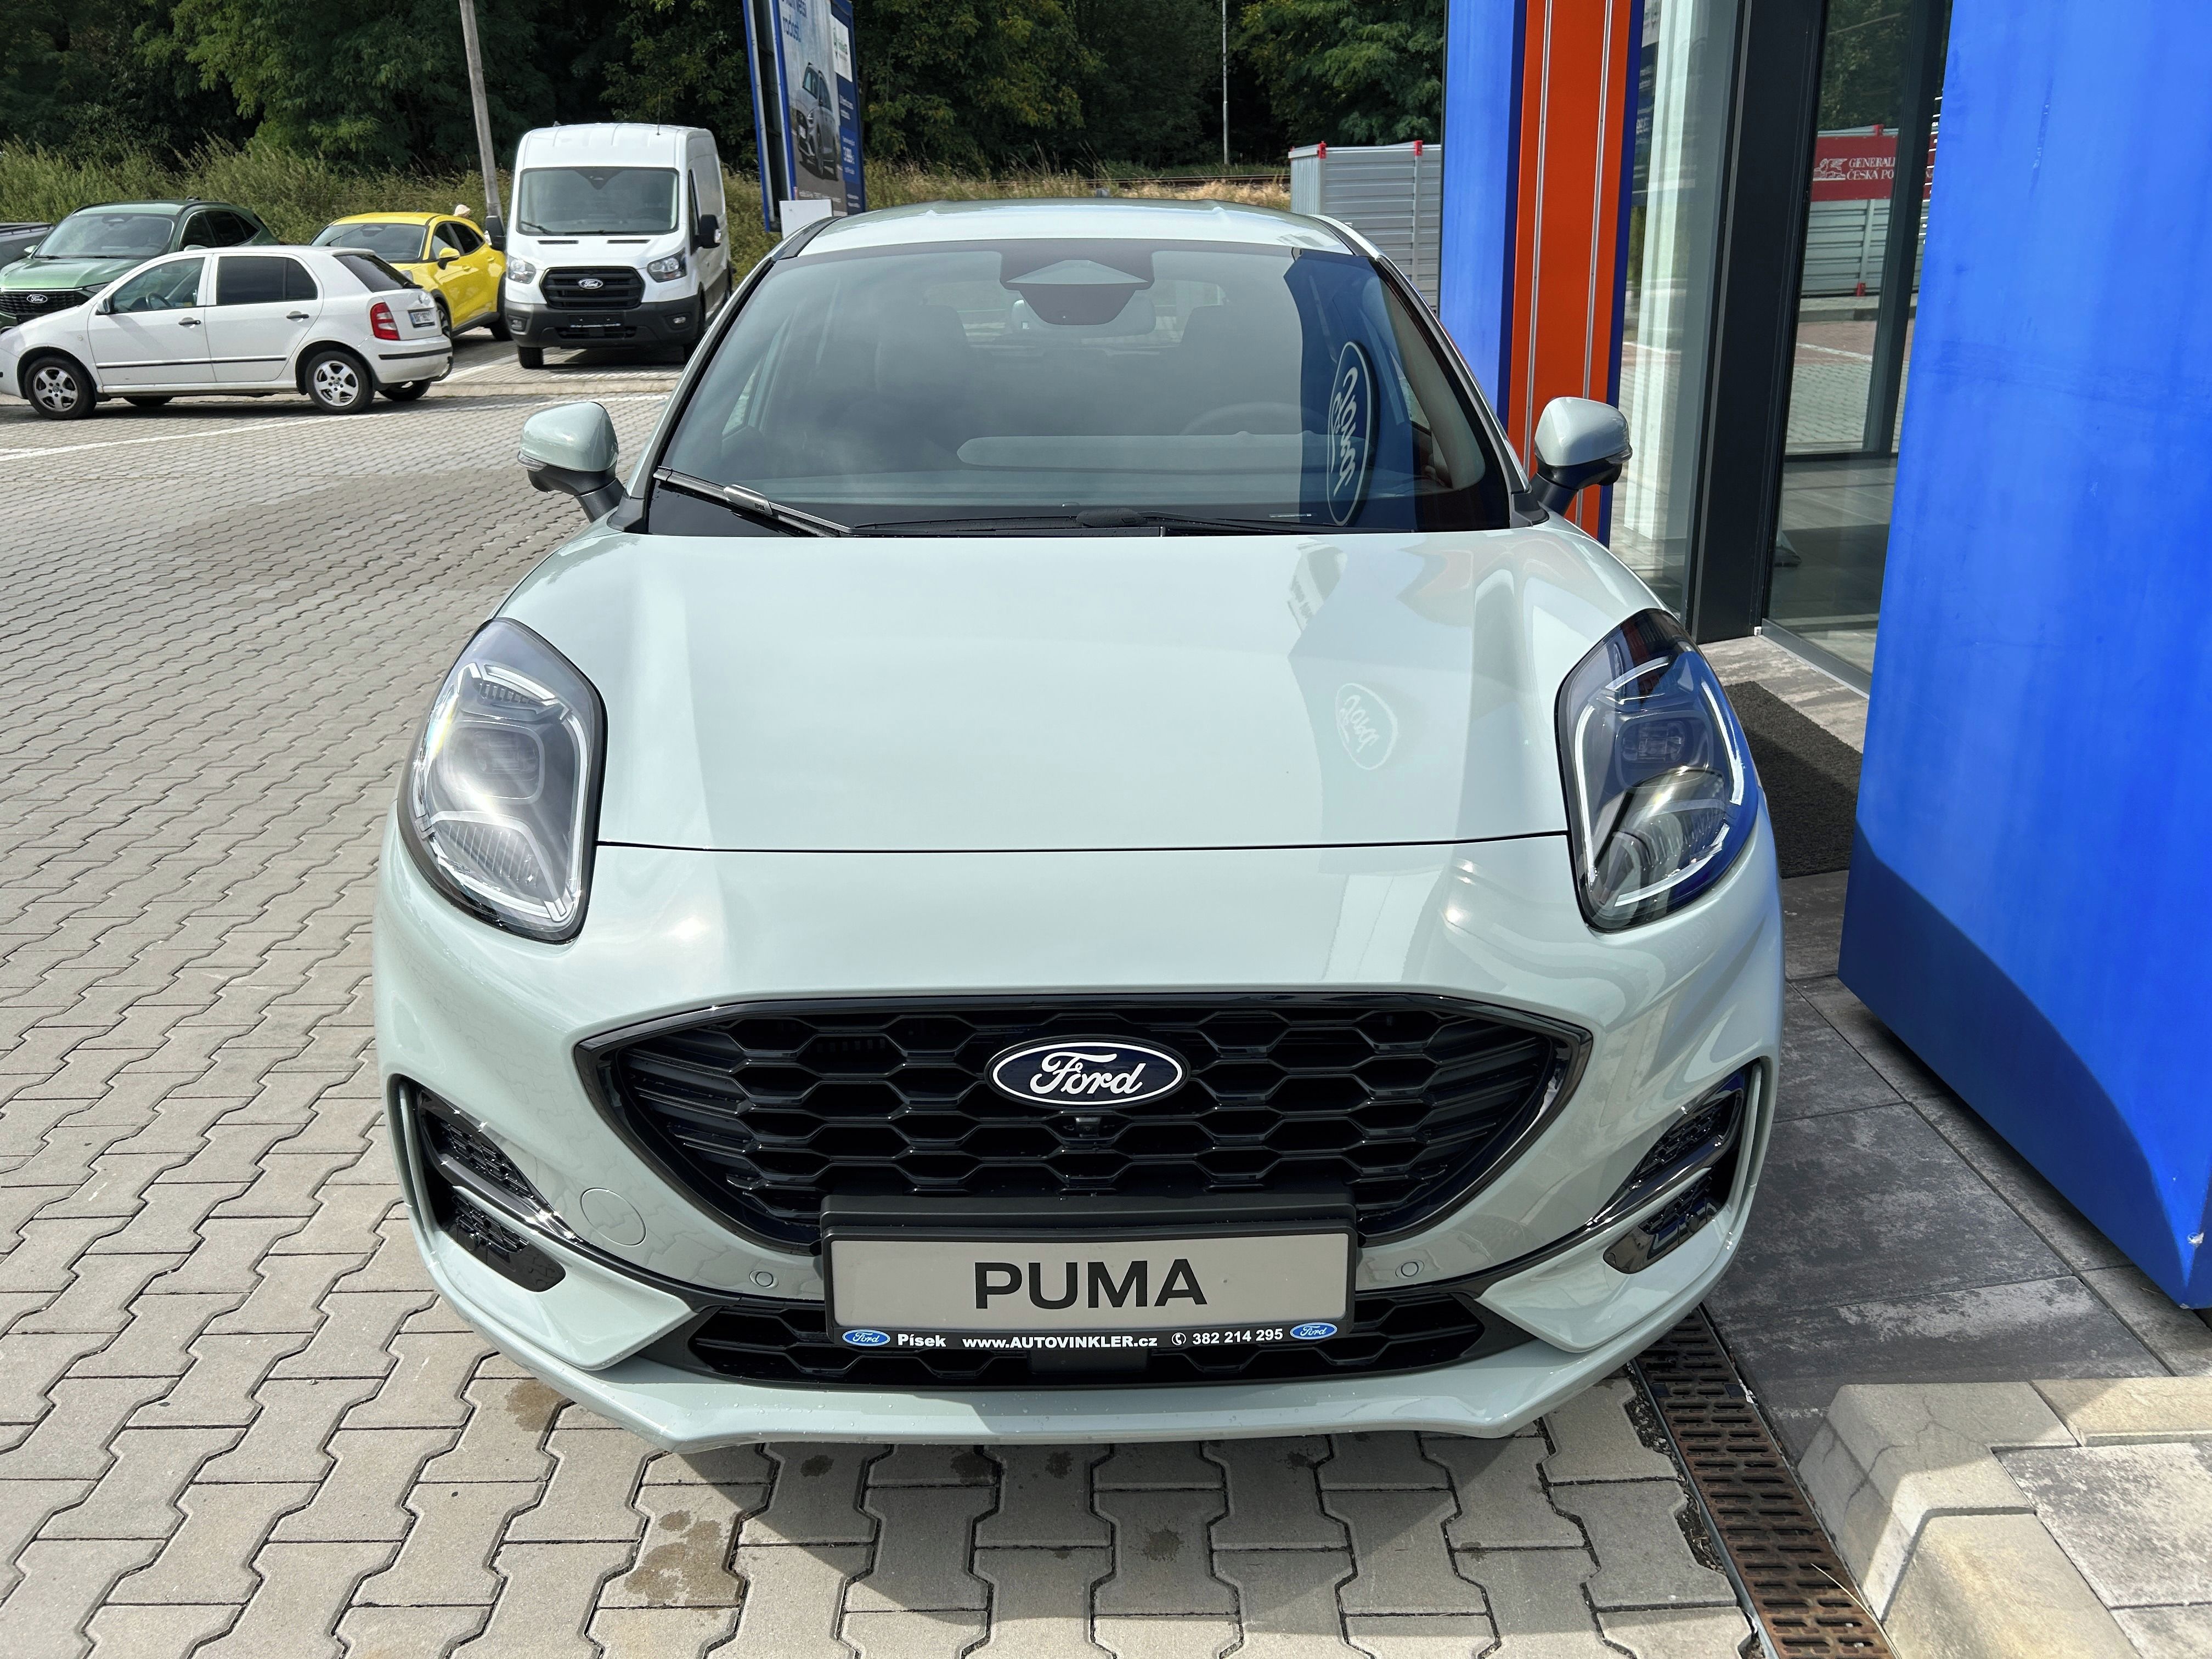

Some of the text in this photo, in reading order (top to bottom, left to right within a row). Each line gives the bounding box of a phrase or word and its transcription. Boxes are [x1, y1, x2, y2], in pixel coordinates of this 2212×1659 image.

[1847, 168, 1878, 180] ČESKÁ
[1029, 1051, 1147, 1095] Ford
[974, 1258, 1208, 1311] PUMA
[898, 1334, 947, 1347] Písek
[963, 1334, 1158, 1349] www.AUTOVINKLER.cz
[1192, 1333, 1220, 1345] 382
[1224, 1330, 1252, 1343] 214
[1256, 1328, 1284, 1341] 295
